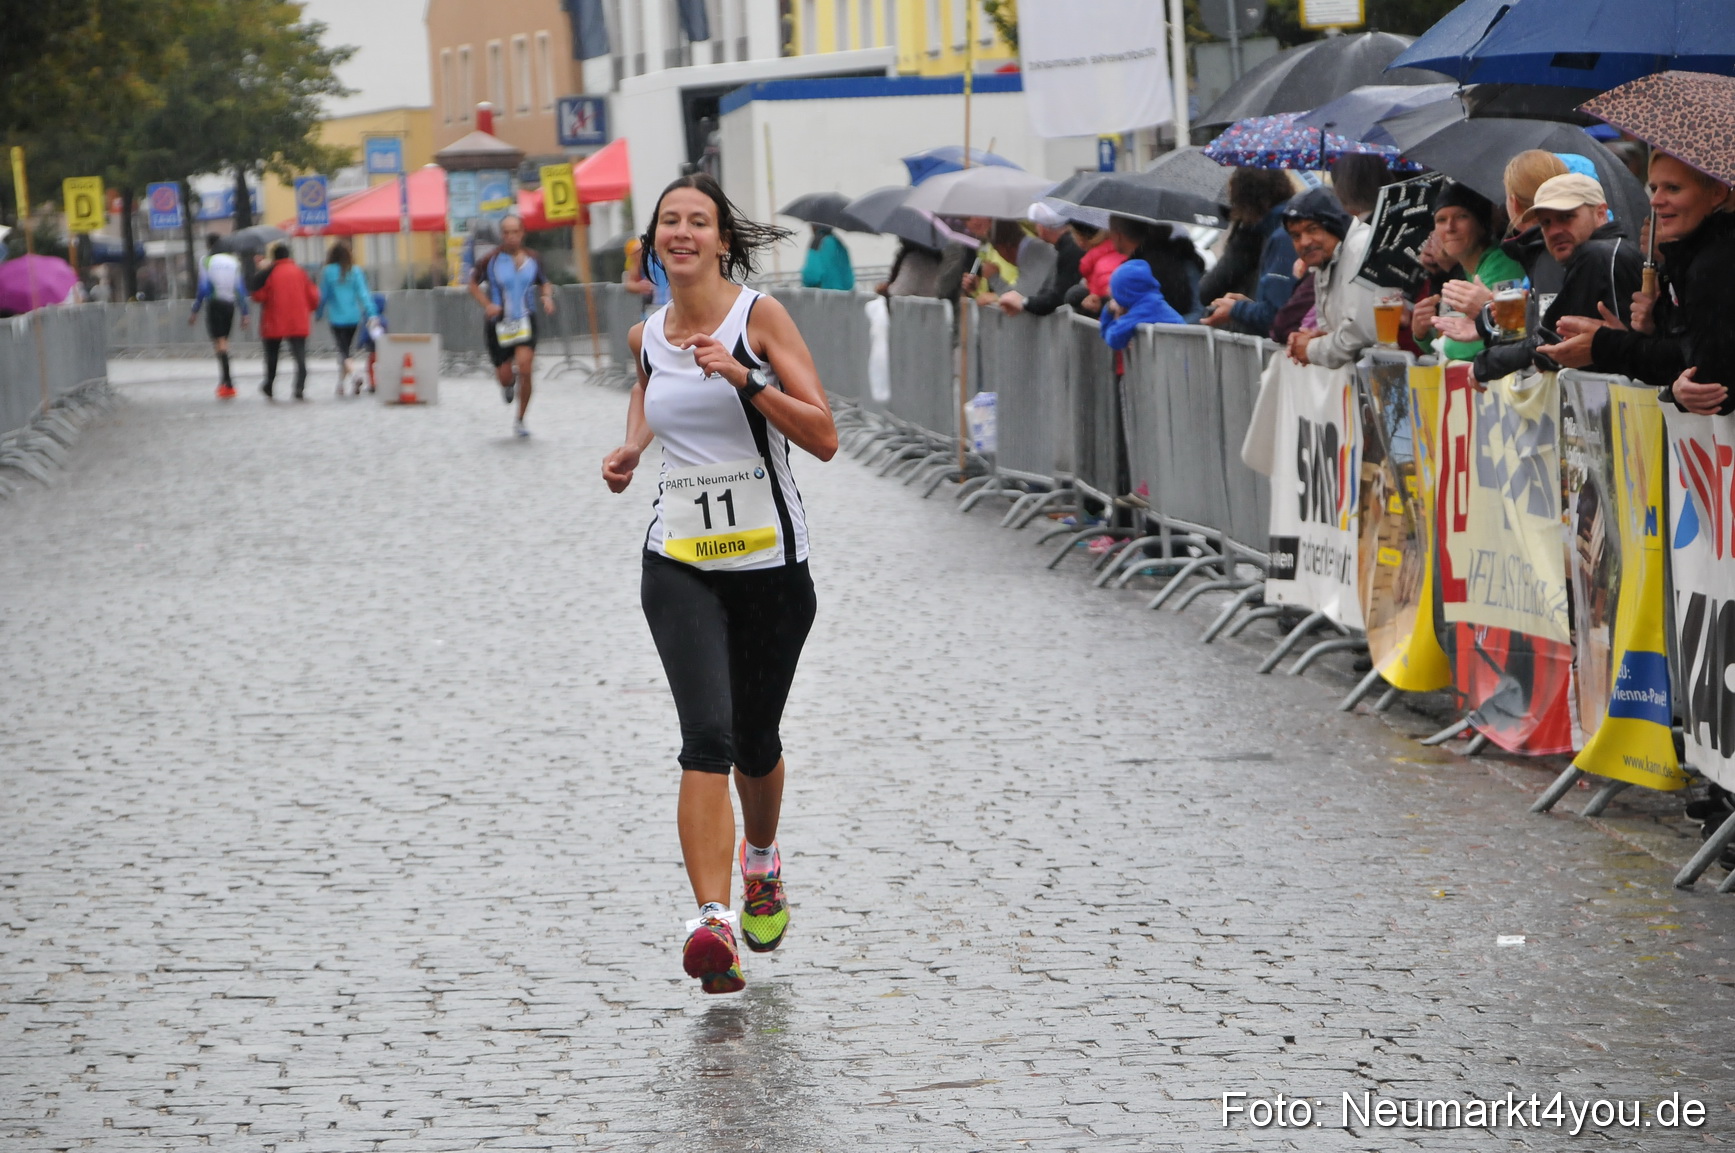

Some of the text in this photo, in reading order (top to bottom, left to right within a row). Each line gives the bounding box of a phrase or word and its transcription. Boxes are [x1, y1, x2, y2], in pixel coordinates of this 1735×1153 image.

[551, 180, 567, 204] D
[75, 193, 91, 218] D
[665, 471, 750, 490] PARTL Neumarkt
[694, 488, 736, 529] 11
[695, 540, 746, 557] Milena
